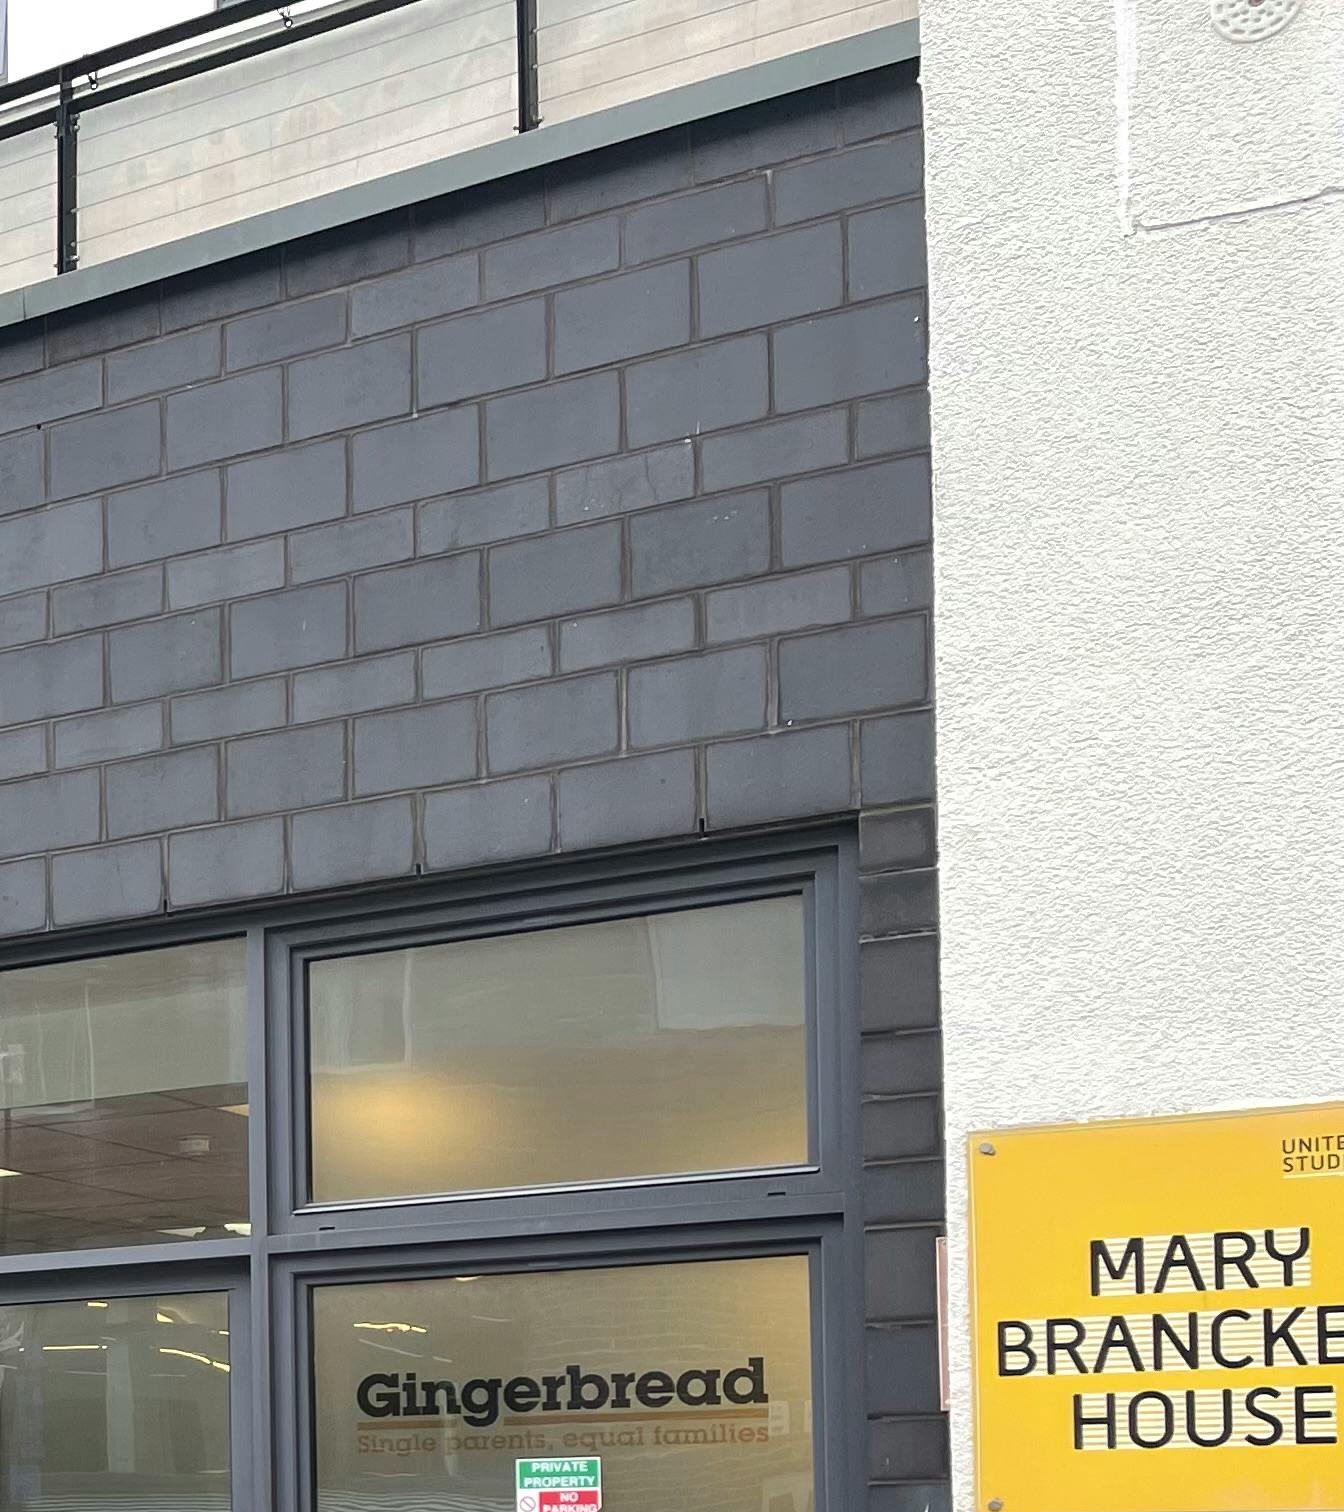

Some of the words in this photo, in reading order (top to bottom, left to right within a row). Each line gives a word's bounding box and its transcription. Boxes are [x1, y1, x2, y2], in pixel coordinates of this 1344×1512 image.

[1282, 1135, 1344, 1154] UNITE
[1282, 1154, 1344, 1173] STUD
[1090, 1226, 1310, 1296] MARY
[998, 1305, 1344, 1377] BRANCKE
[357, 1357, 769, 1427] Gingerbread
[1073, 1385, 1337, 1450] HOUSE
[358, 1433, 437, 1456] Single
[563, 1427, 644, 1451] equal
[653, 1423, 769, 1446] families
[532, 1461, 588, 1472] PRIVATE
[524, 1475, 595, 1487] PROPERTY
[560, 1492, 579, 1503] NO
